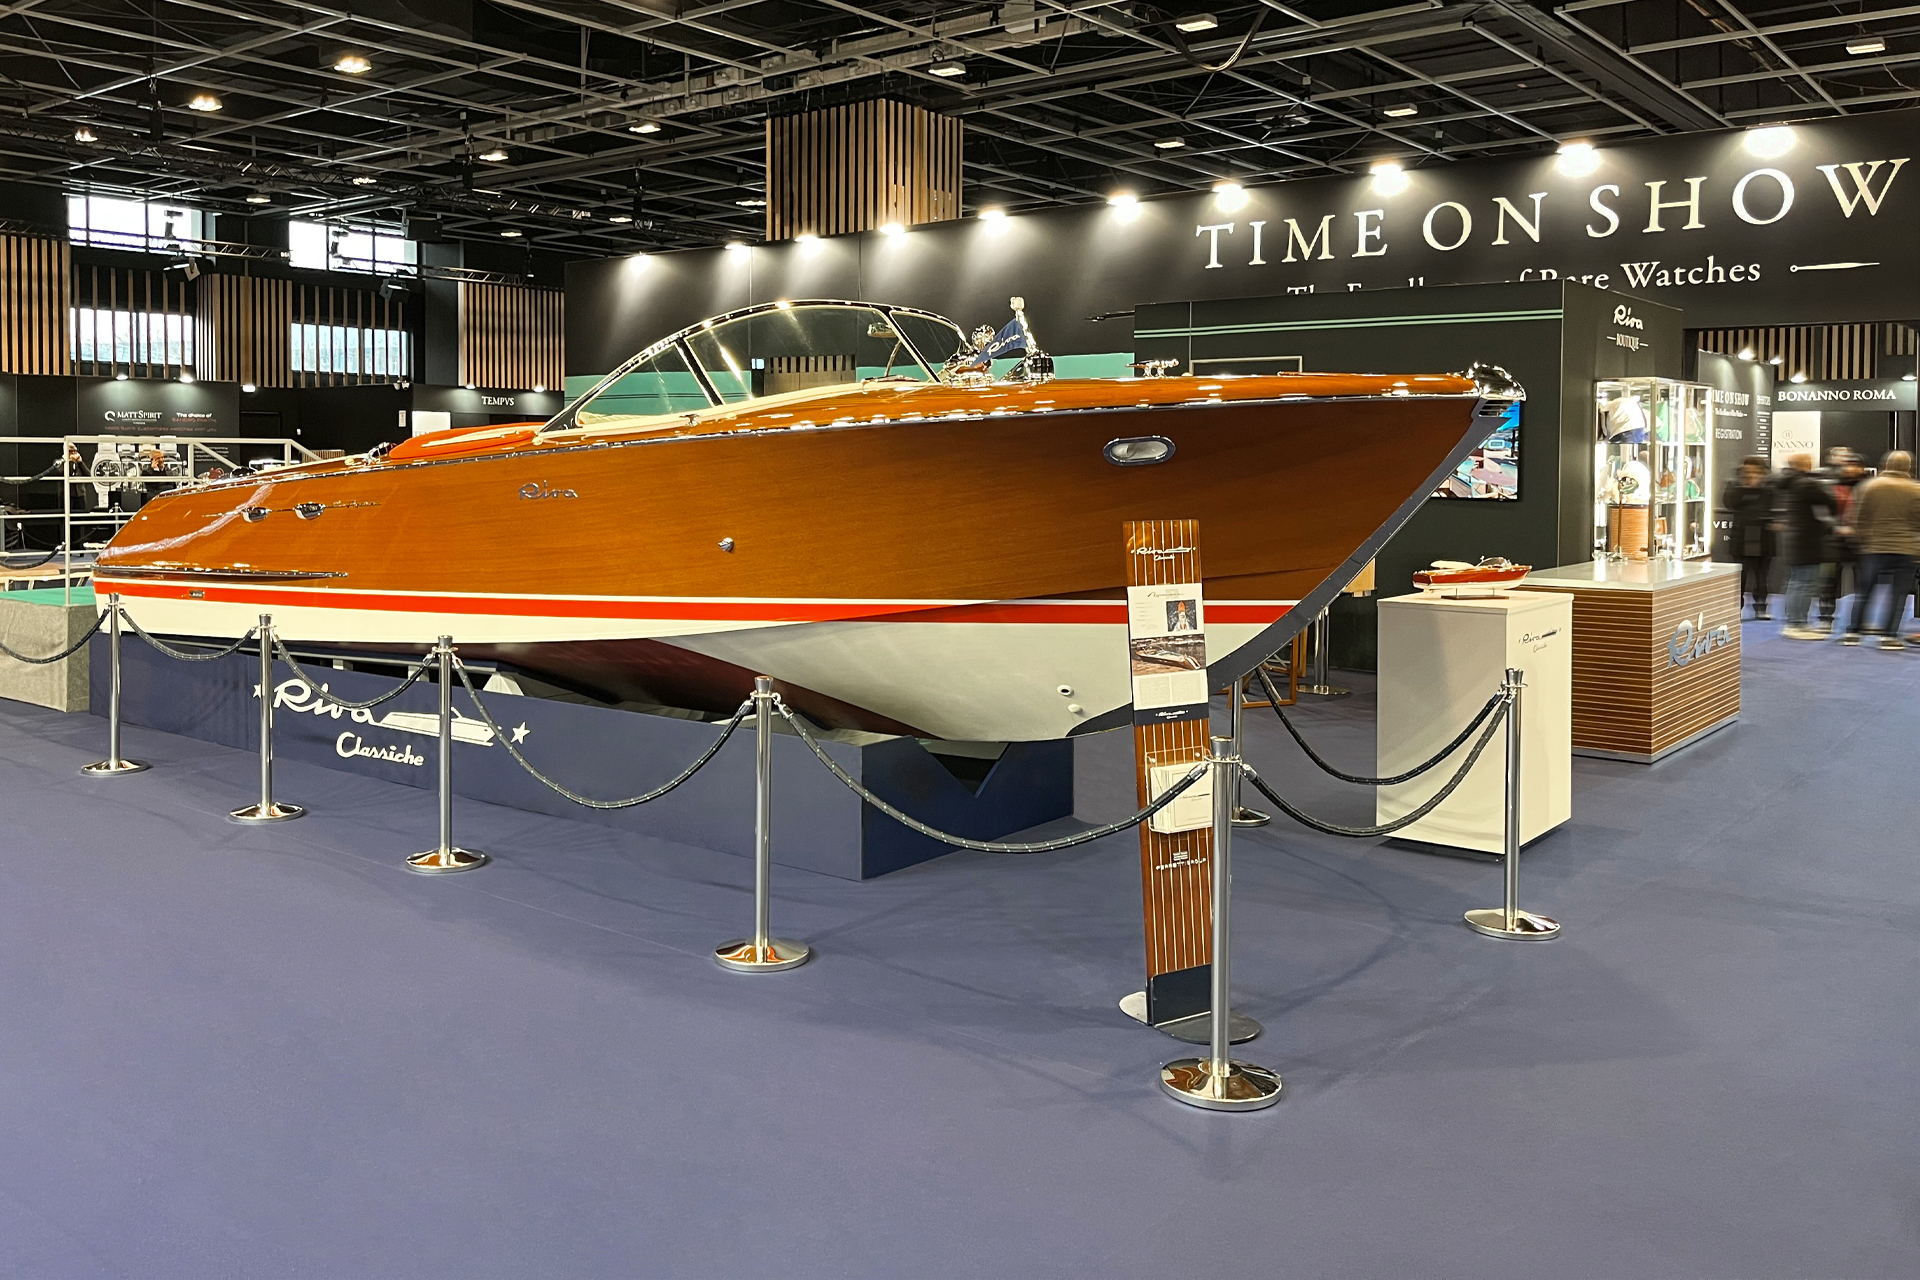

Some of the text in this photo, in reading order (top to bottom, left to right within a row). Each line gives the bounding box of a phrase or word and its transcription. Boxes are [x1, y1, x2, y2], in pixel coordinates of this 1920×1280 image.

[1196, 157, 1911, 269] TIME ON SHOW
[1620, 255, 1761, 289] Watches
[1613, 304, 1644, 330] Riva
[987, 334, 1021, 357] Riva
[481, 396, 515, 406] TEMPVS
[1778, 390, 1850, 402] BONANNO
[1853, 389, 1897, 400] ROMA
[519, 480, 578, 500] Riva
[1667, 612, 1731, 669] Riva
[273, 678, 375, 725] Riva
[336, 731, 425, 767] Classiche
